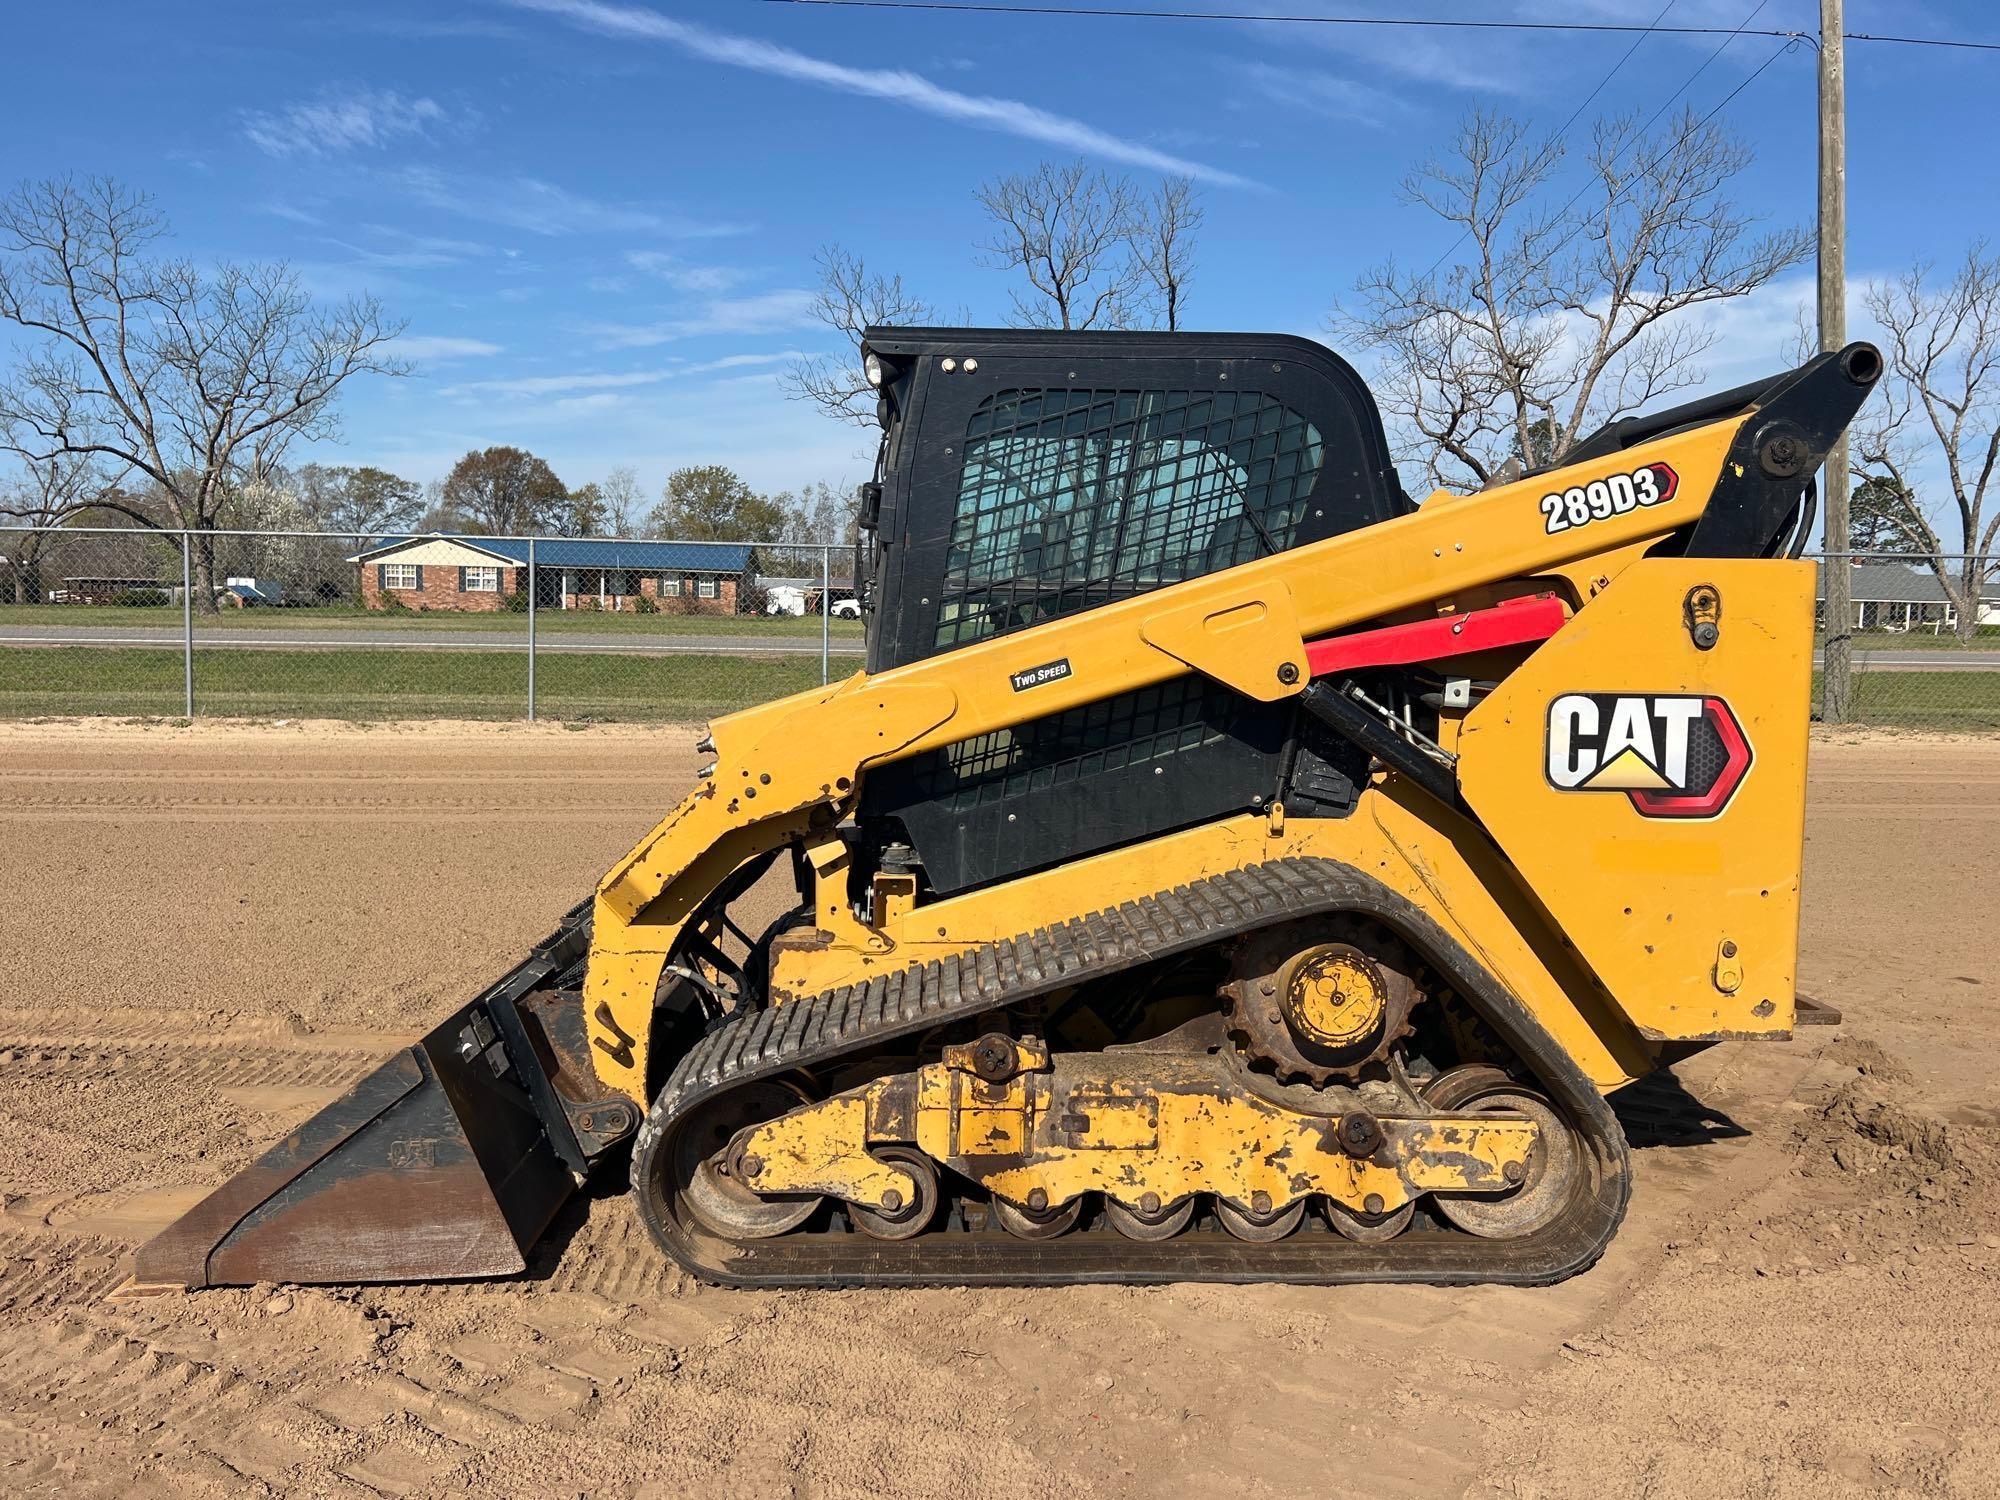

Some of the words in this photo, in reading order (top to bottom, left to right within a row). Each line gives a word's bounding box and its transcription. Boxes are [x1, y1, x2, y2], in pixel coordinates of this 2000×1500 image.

[1541, 467, 1660, 534] 289D3
[1014, 673, 1036, 688] TWO
[1037, 664, 1067, 681] SPEED
[1549, 695, 1703, 789] CAT
